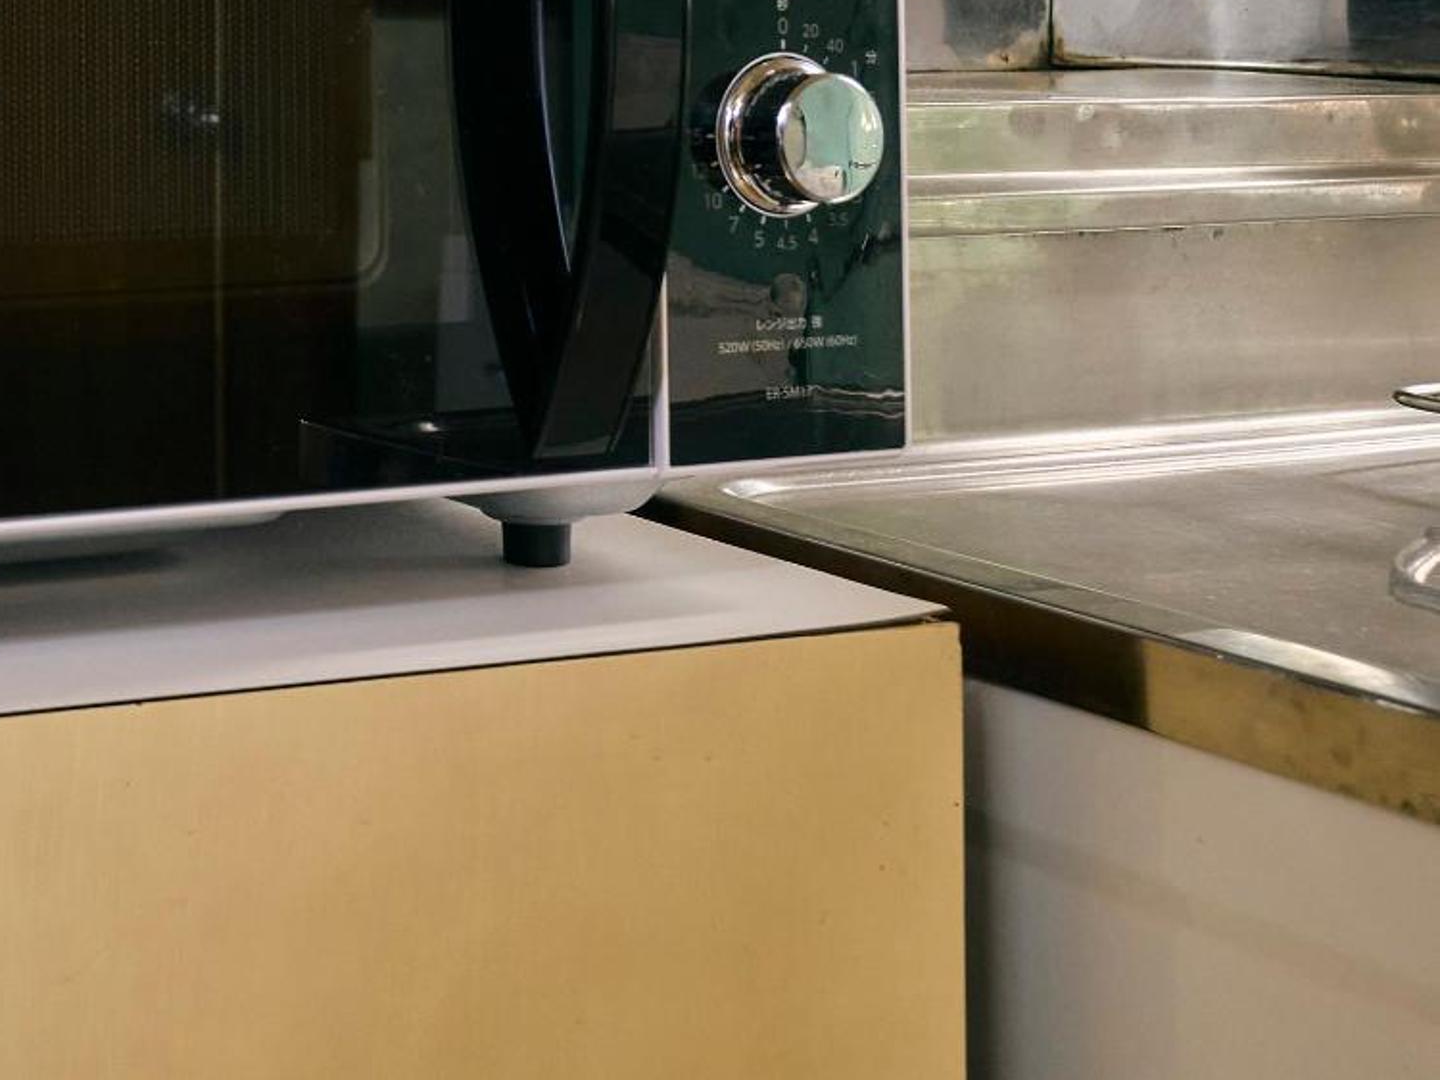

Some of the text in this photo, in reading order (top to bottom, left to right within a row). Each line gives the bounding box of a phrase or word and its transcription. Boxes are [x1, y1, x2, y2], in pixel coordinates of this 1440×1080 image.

[777, 17, 788, 35] 0
[802, 23, 820, 38] 20
[826, 38, 844, 54] 40
[704, 194, 722, 210] 10
[728, 216, 739, 234] 7
[754, 230, 766, 248] 5
[807, 229, 819, 245] 4
